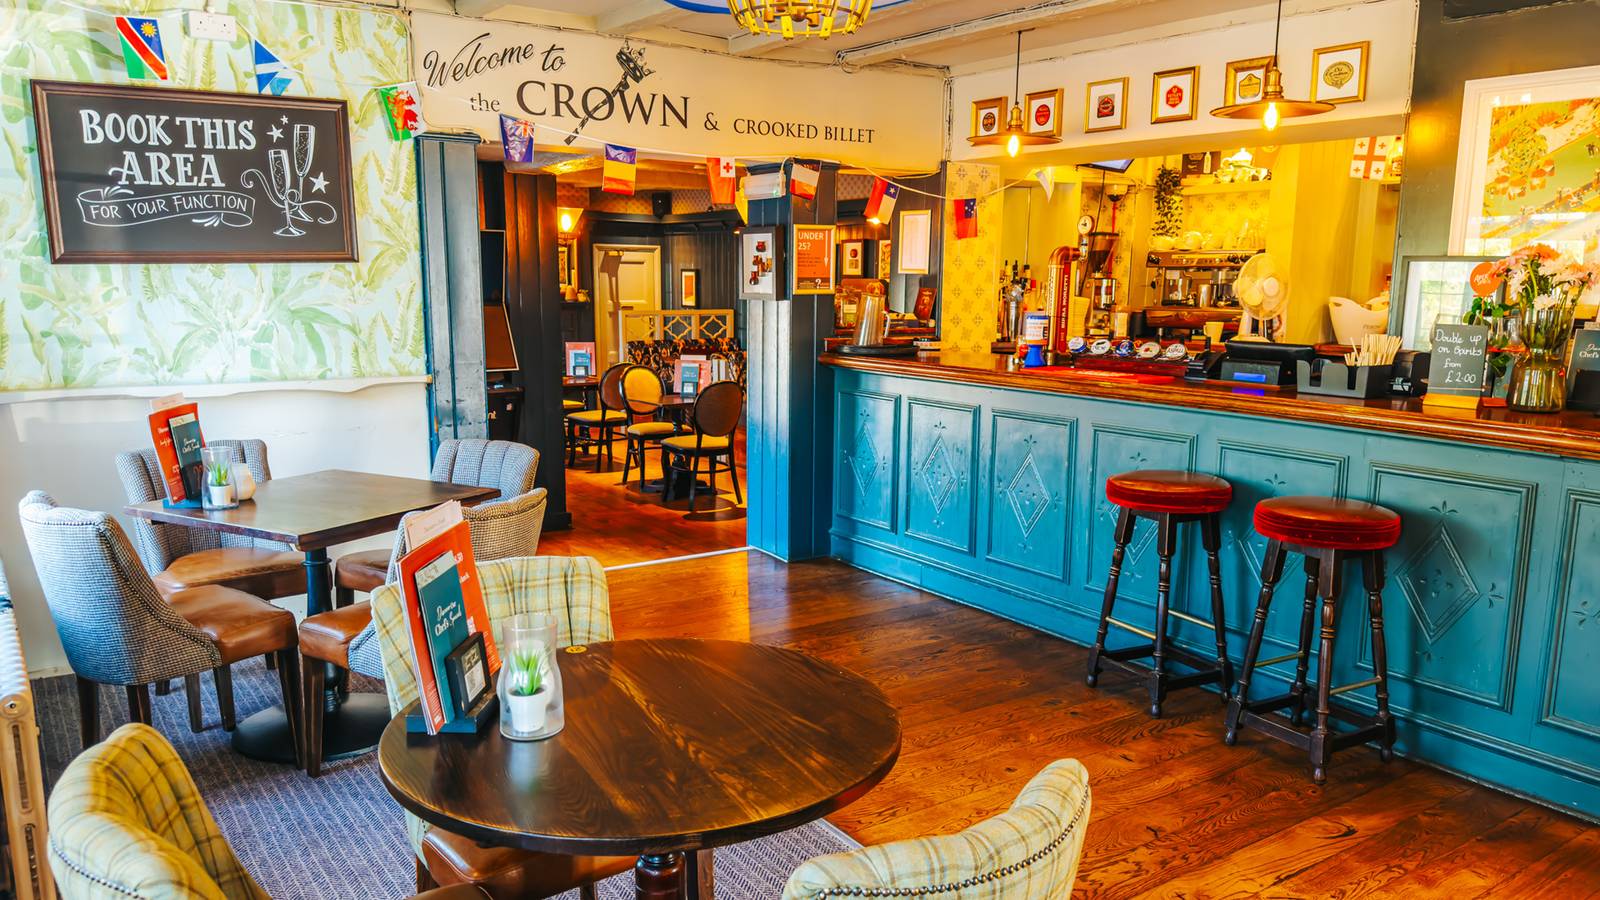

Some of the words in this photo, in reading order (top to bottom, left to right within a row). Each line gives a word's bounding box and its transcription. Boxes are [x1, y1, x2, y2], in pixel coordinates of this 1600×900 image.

[423, 32, 534, 88] Welcome
[541, 44, 566, 73] to
[470, 93, 500, 112] the
[516, 80, 691, 129] CROWN
[704, 111, 720, 131] &
[733, 118, 818, 139] CROOKED
[824, 126, 875, 143] BILLET
[79, 109, 173, 146] BOOK
[175, 116, 257, 150] THIS
[108, 151, 225, 188] AREA
[90, 204, 120, 220] FOR
[127, 198, 168, 219] YOUR
[173, 194, 248, 212] FUNCTION
[798, 232, 824, 240] UNDER
[798, 242, 811, 250] 25?
[1435, 329, 1464, 344] Double
[1469, 335, 1482, 345] up
[1443, 358, 1461, 368] from
